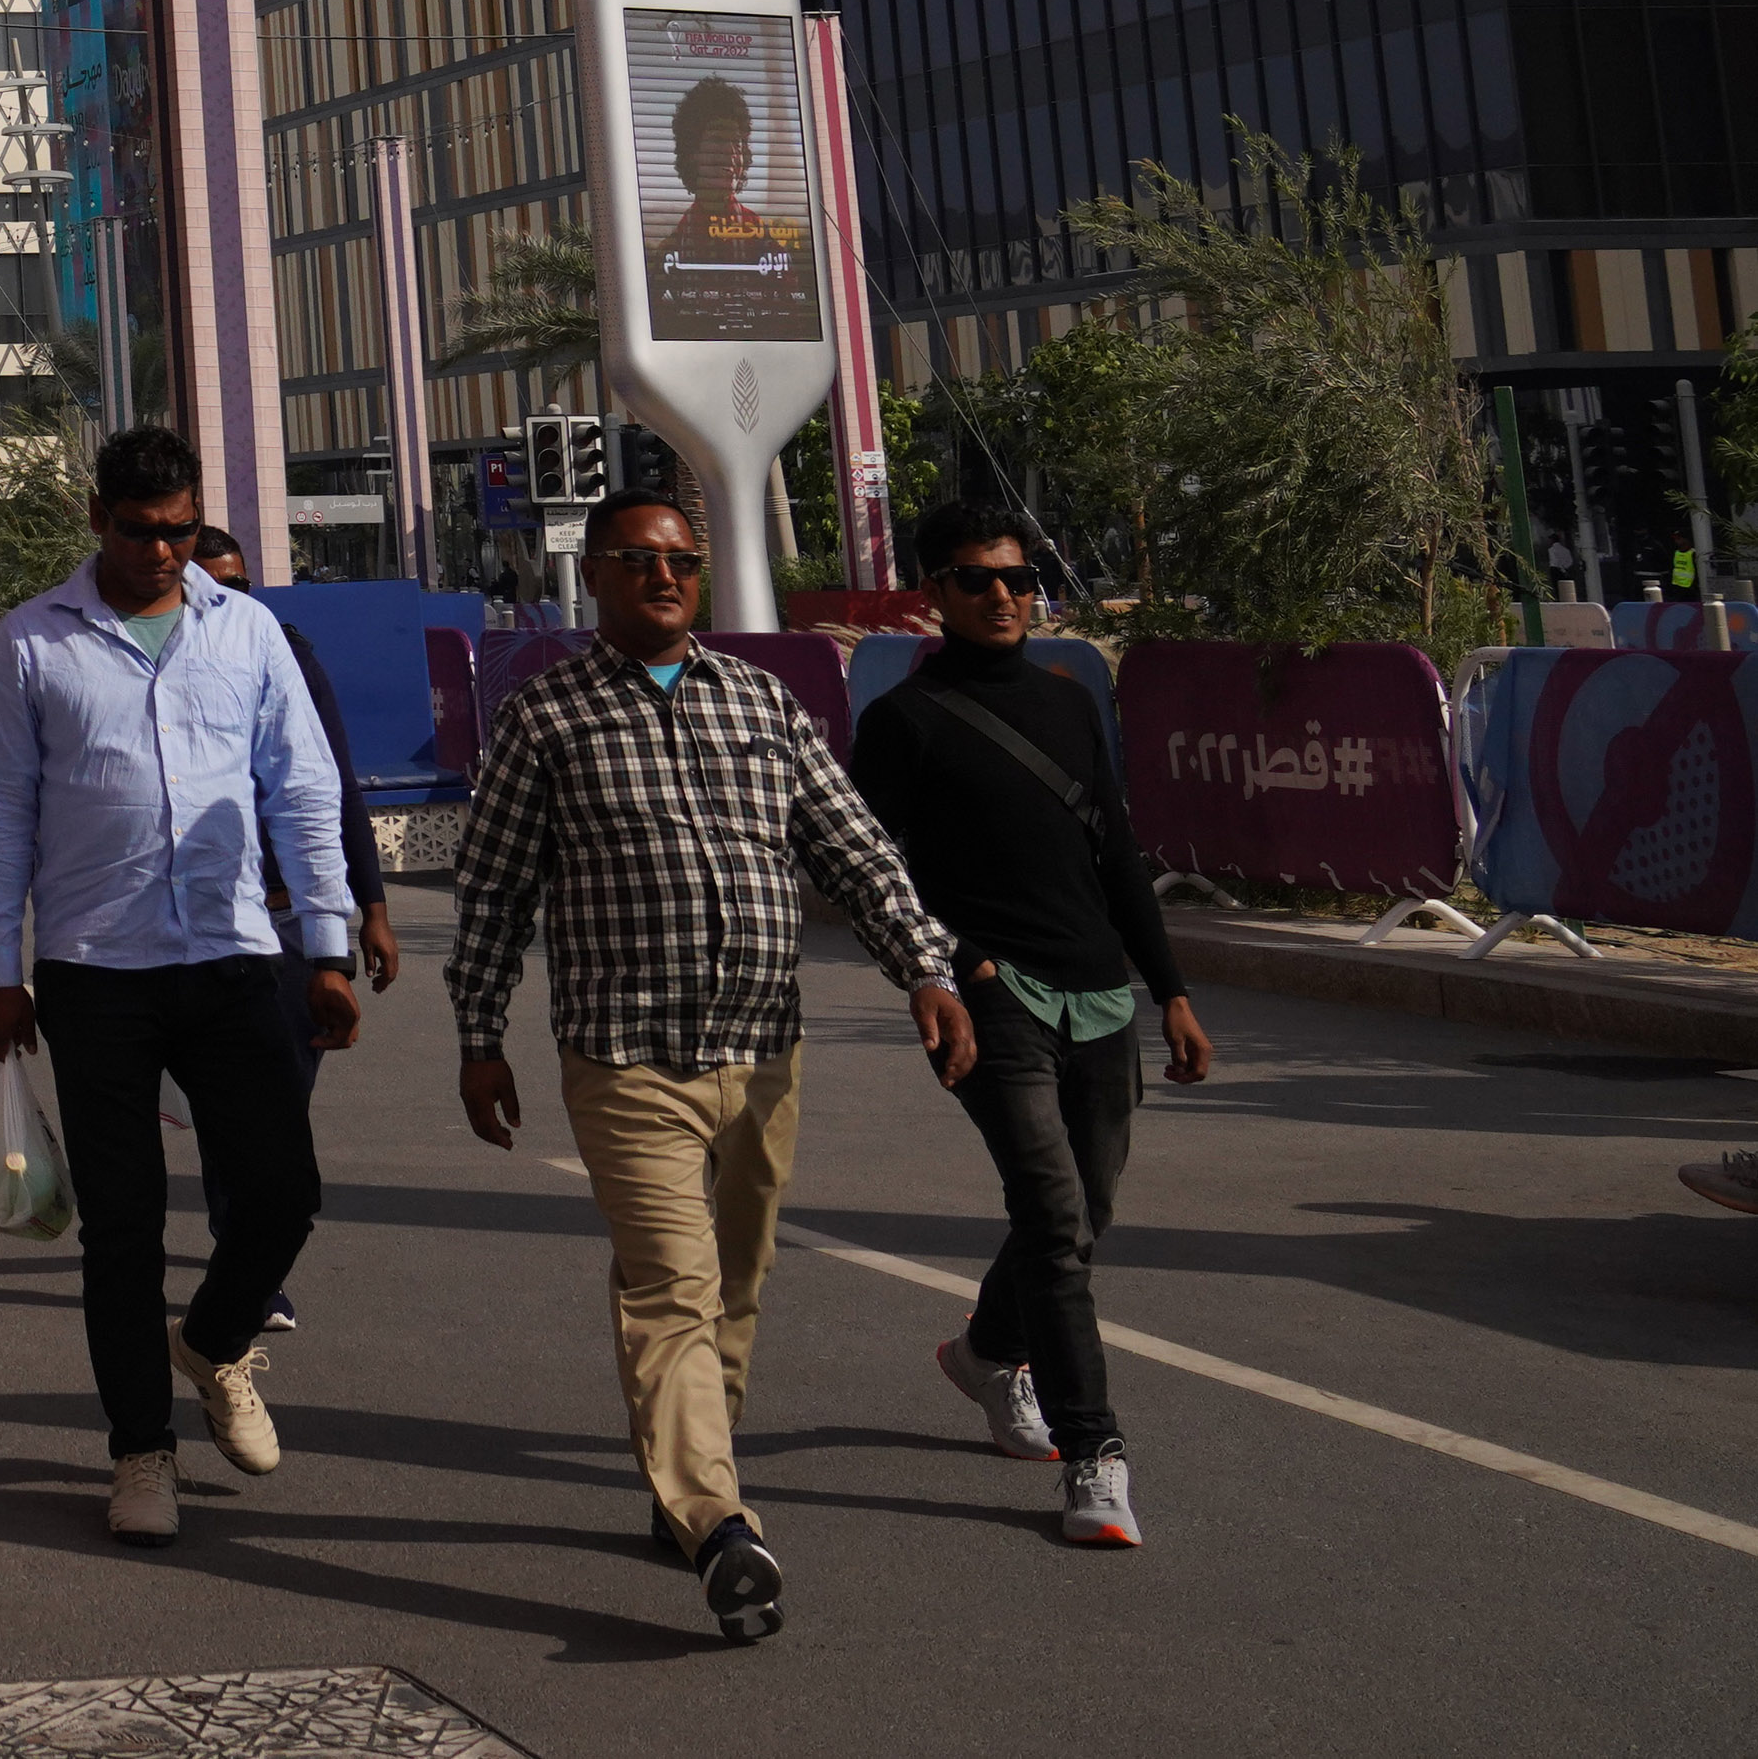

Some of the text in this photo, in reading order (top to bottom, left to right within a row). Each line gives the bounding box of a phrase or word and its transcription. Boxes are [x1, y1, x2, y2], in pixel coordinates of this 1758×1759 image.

[685, 32, 753, 45] FIFA WORLD CUP
[708, 215, 765, 241] لحظة
[490, 463, 503, 473] P1
